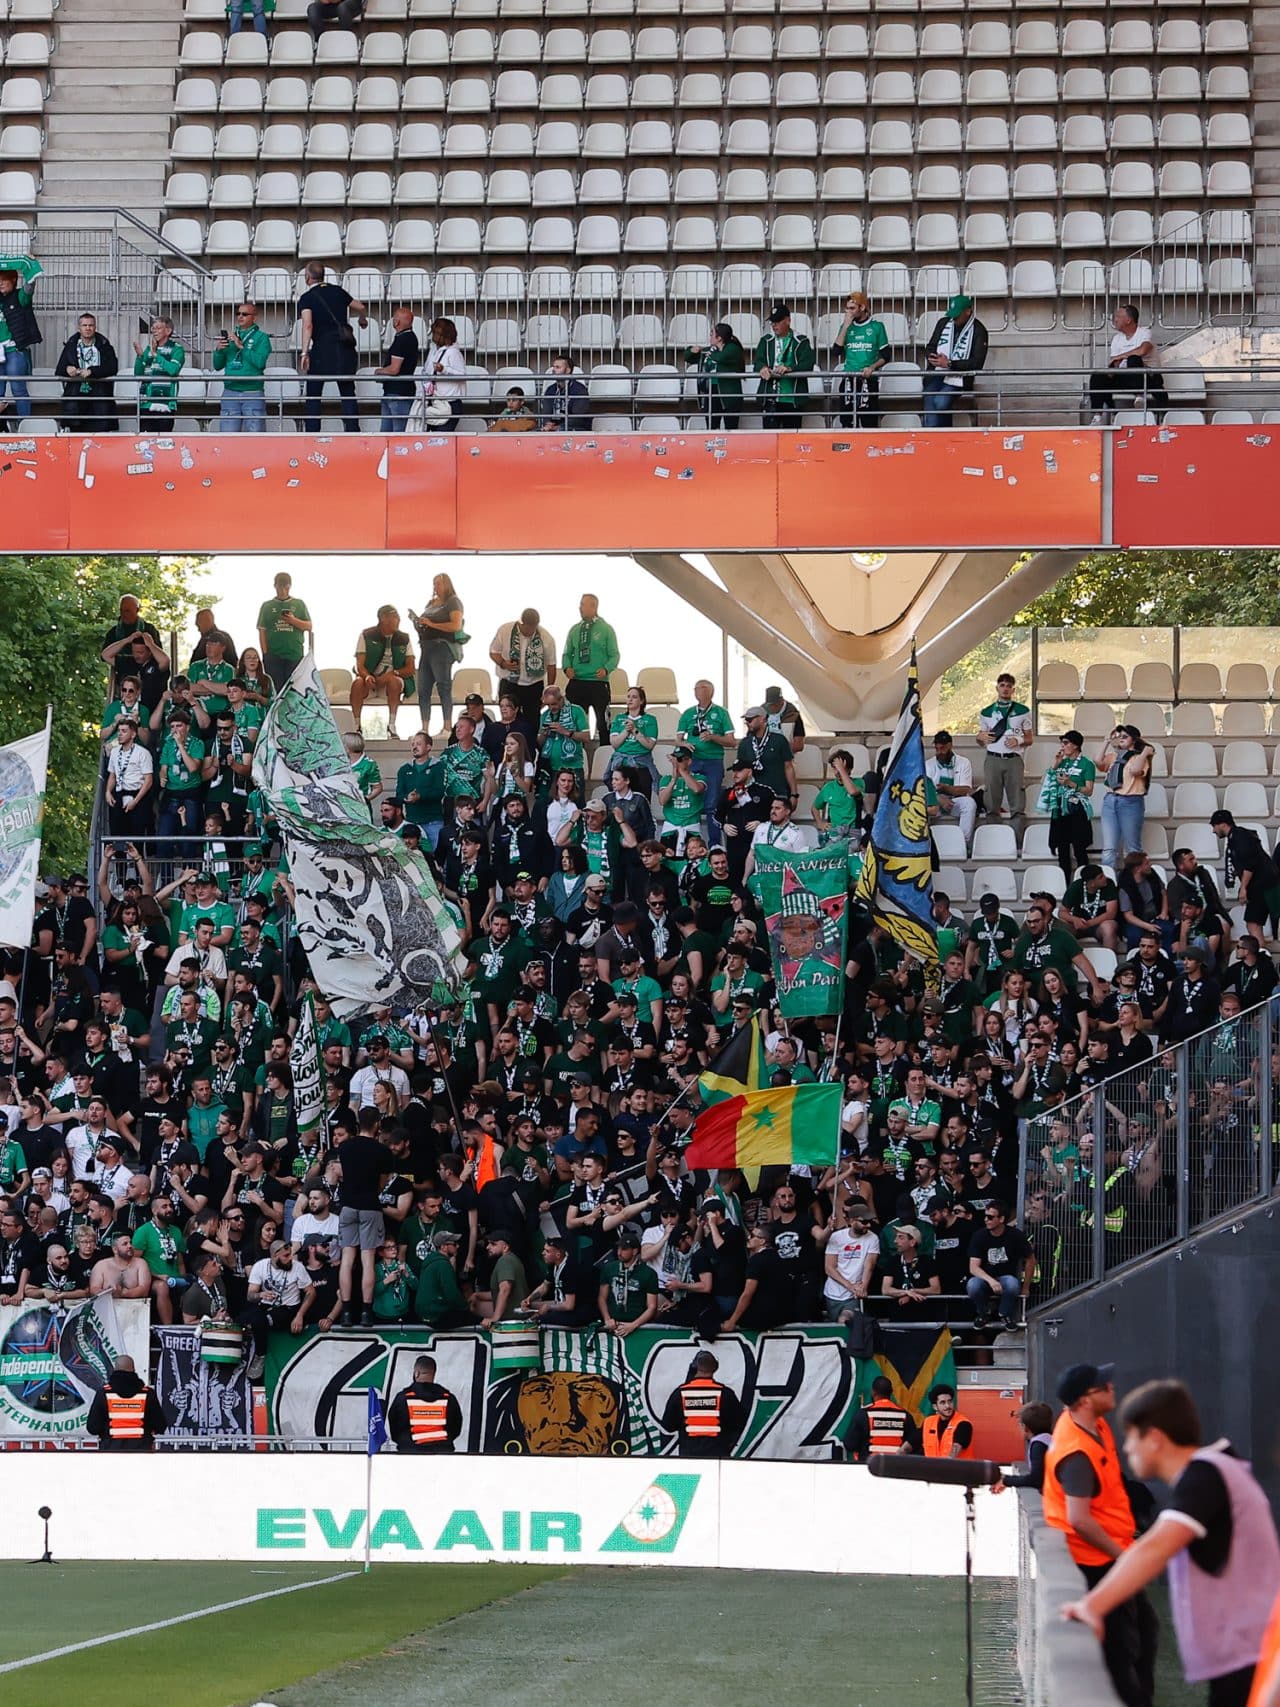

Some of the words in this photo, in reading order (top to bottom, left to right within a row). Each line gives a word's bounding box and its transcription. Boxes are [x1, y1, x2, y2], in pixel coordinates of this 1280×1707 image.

[165, 1335, 201, 1352] GREEN
[256, 1508, 425, 1550] EVA
[433, 1510, 582, 1552] AIR
